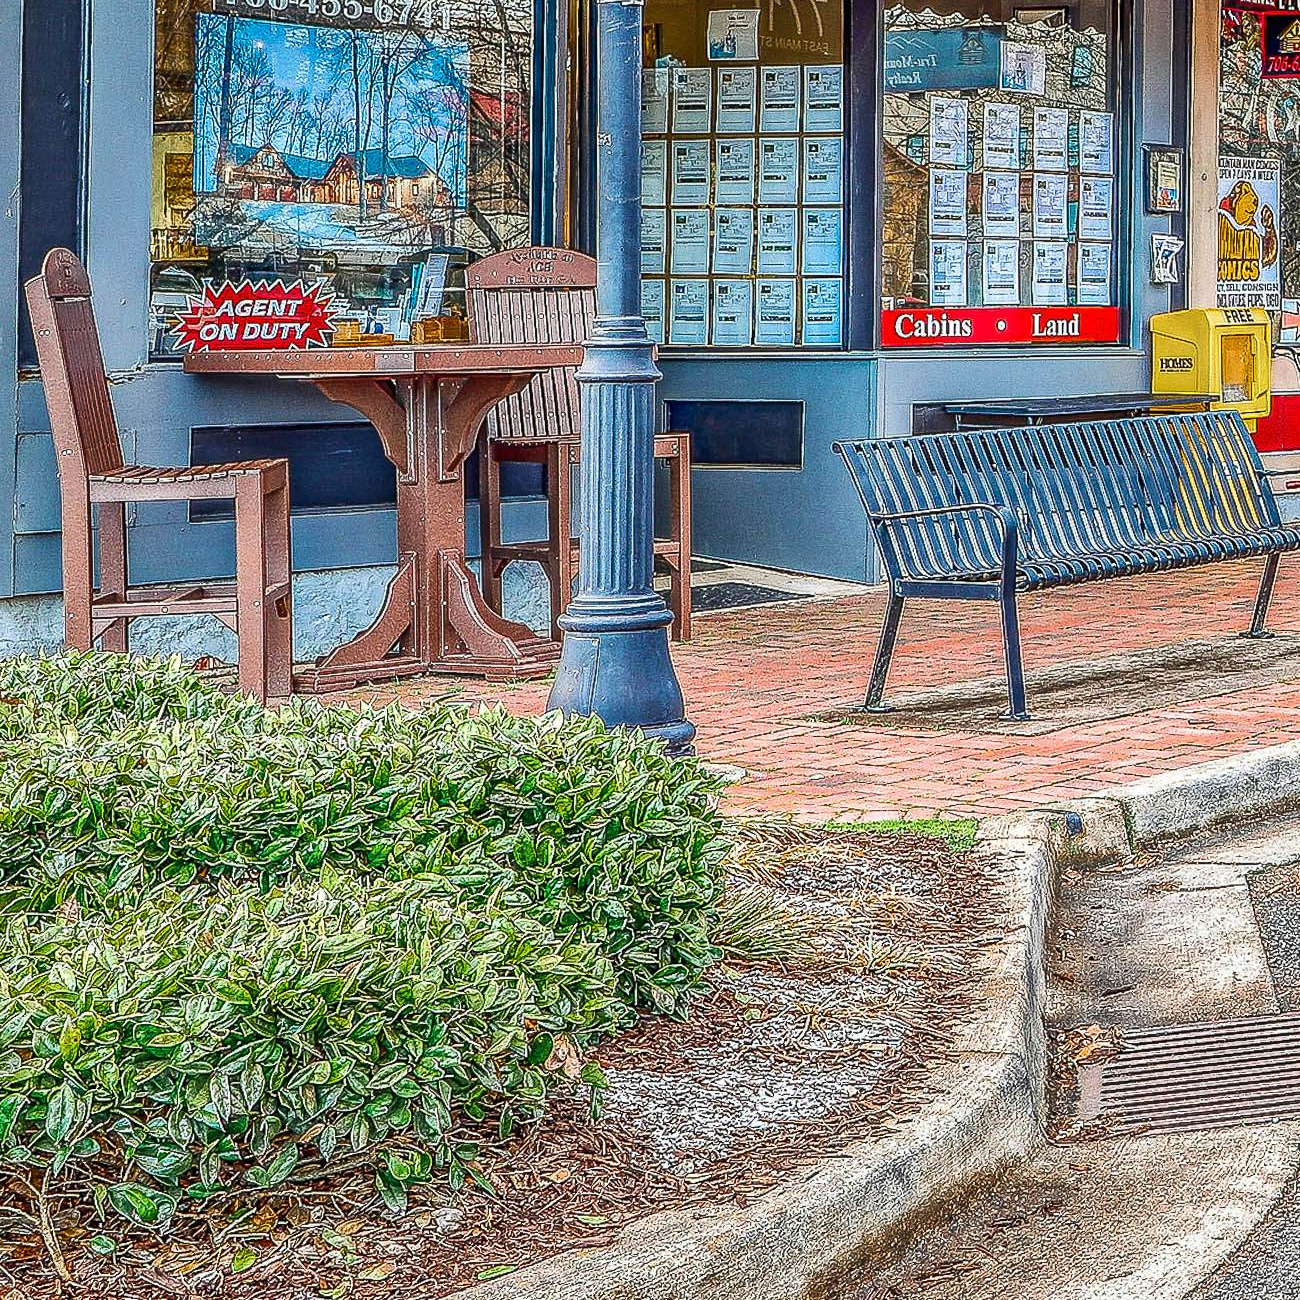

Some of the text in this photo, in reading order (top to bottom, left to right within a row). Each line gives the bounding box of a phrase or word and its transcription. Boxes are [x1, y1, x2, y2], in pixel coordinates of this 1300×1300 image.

[215, 298, 300, 317] AGENT
[1224, 308, 1254, 324] FREE
[200, 321, 309, 341] ON DUTY
[894, 313, 1081, 339] Cabins Land
[1160, 357, 1193, 369] HOMES
